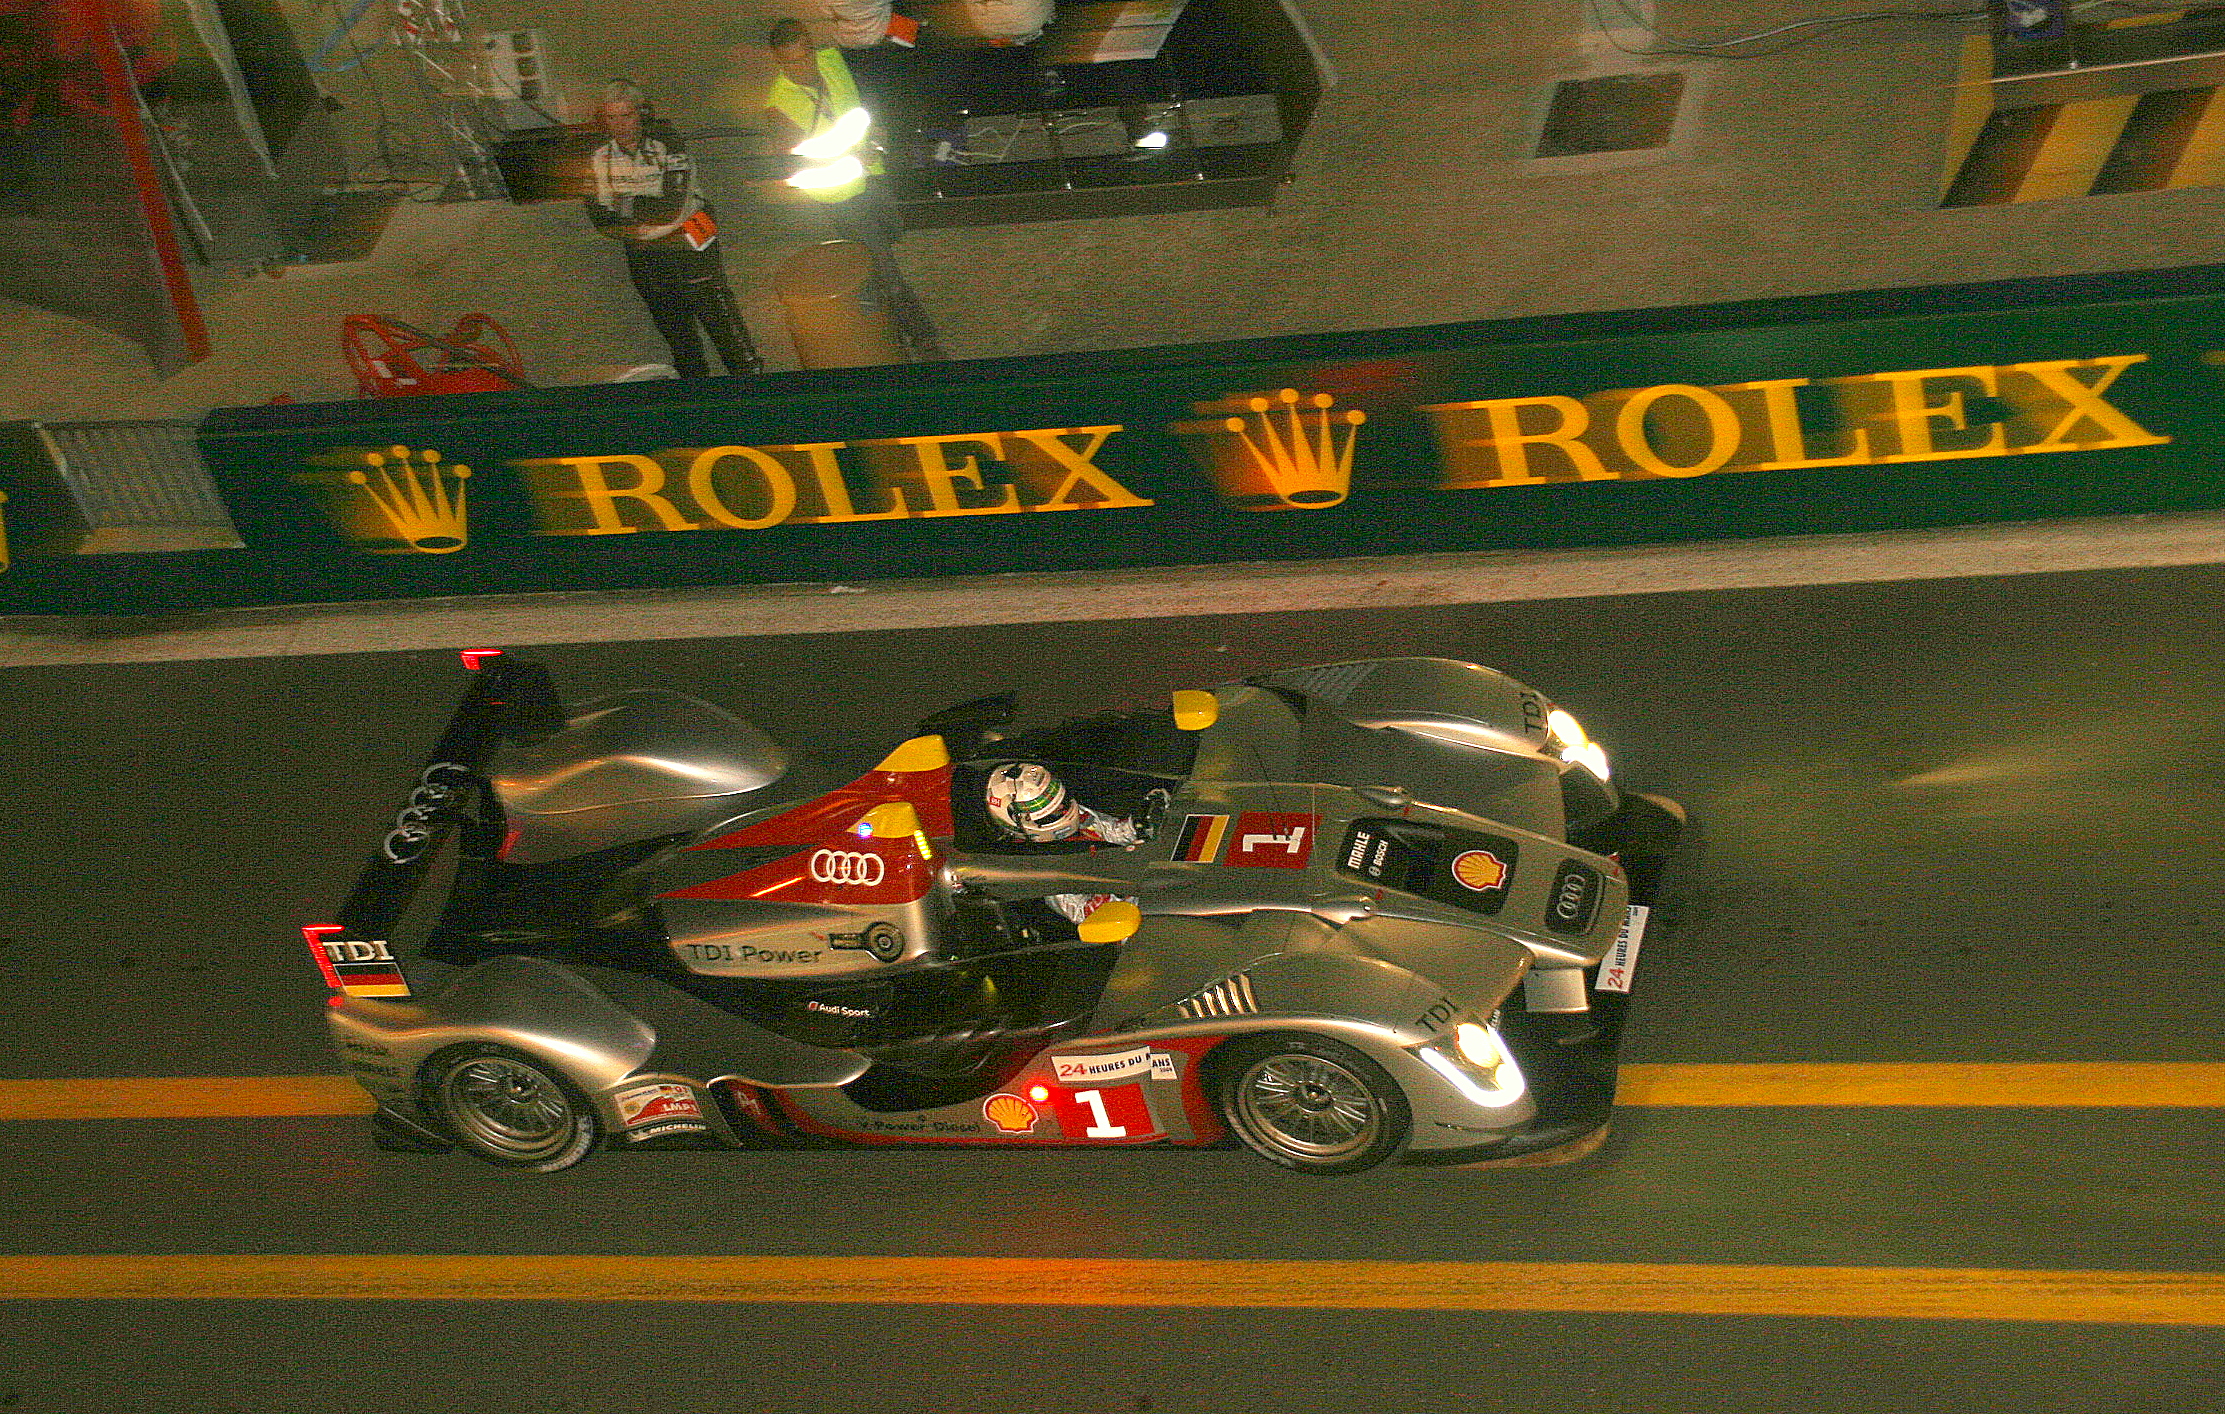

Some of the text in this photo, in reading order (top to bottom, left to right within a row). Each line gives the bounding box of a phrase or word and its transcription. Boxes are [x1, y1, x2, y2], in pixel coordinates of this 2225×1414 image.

[1470, 354, 2171, 489] ROLEX
[558, 424, 1154, 536] ROLEX
[1507, 691, 1541, 734] TDI
[1242, 826, 1305, 853] 1
[1347, 831, 1370, 869] MAHLE
[1373, 840, 1388, 866] BOSCH
[1619, 928, 1629, 939] DU
[322, 940, 394, 961] TDI
[687, 944, 822, 963] TDI Power
[1615, 940, 1628, 967] HEURES
[1607, 968, 1625, 989] 24
[819, 1003, 870, 1018] Audi Sport
[1415, 996, 1459, 1033] TDI
[1059, 1063, 1087, 1077] 24
[1088, 1061, 1126, 1074] HEURES
[1128, 1055, 1142, 1067] DU
[1074, 1090, 1127, 1138] 1
[650, 1123, 706, 1134] MICHELIN
